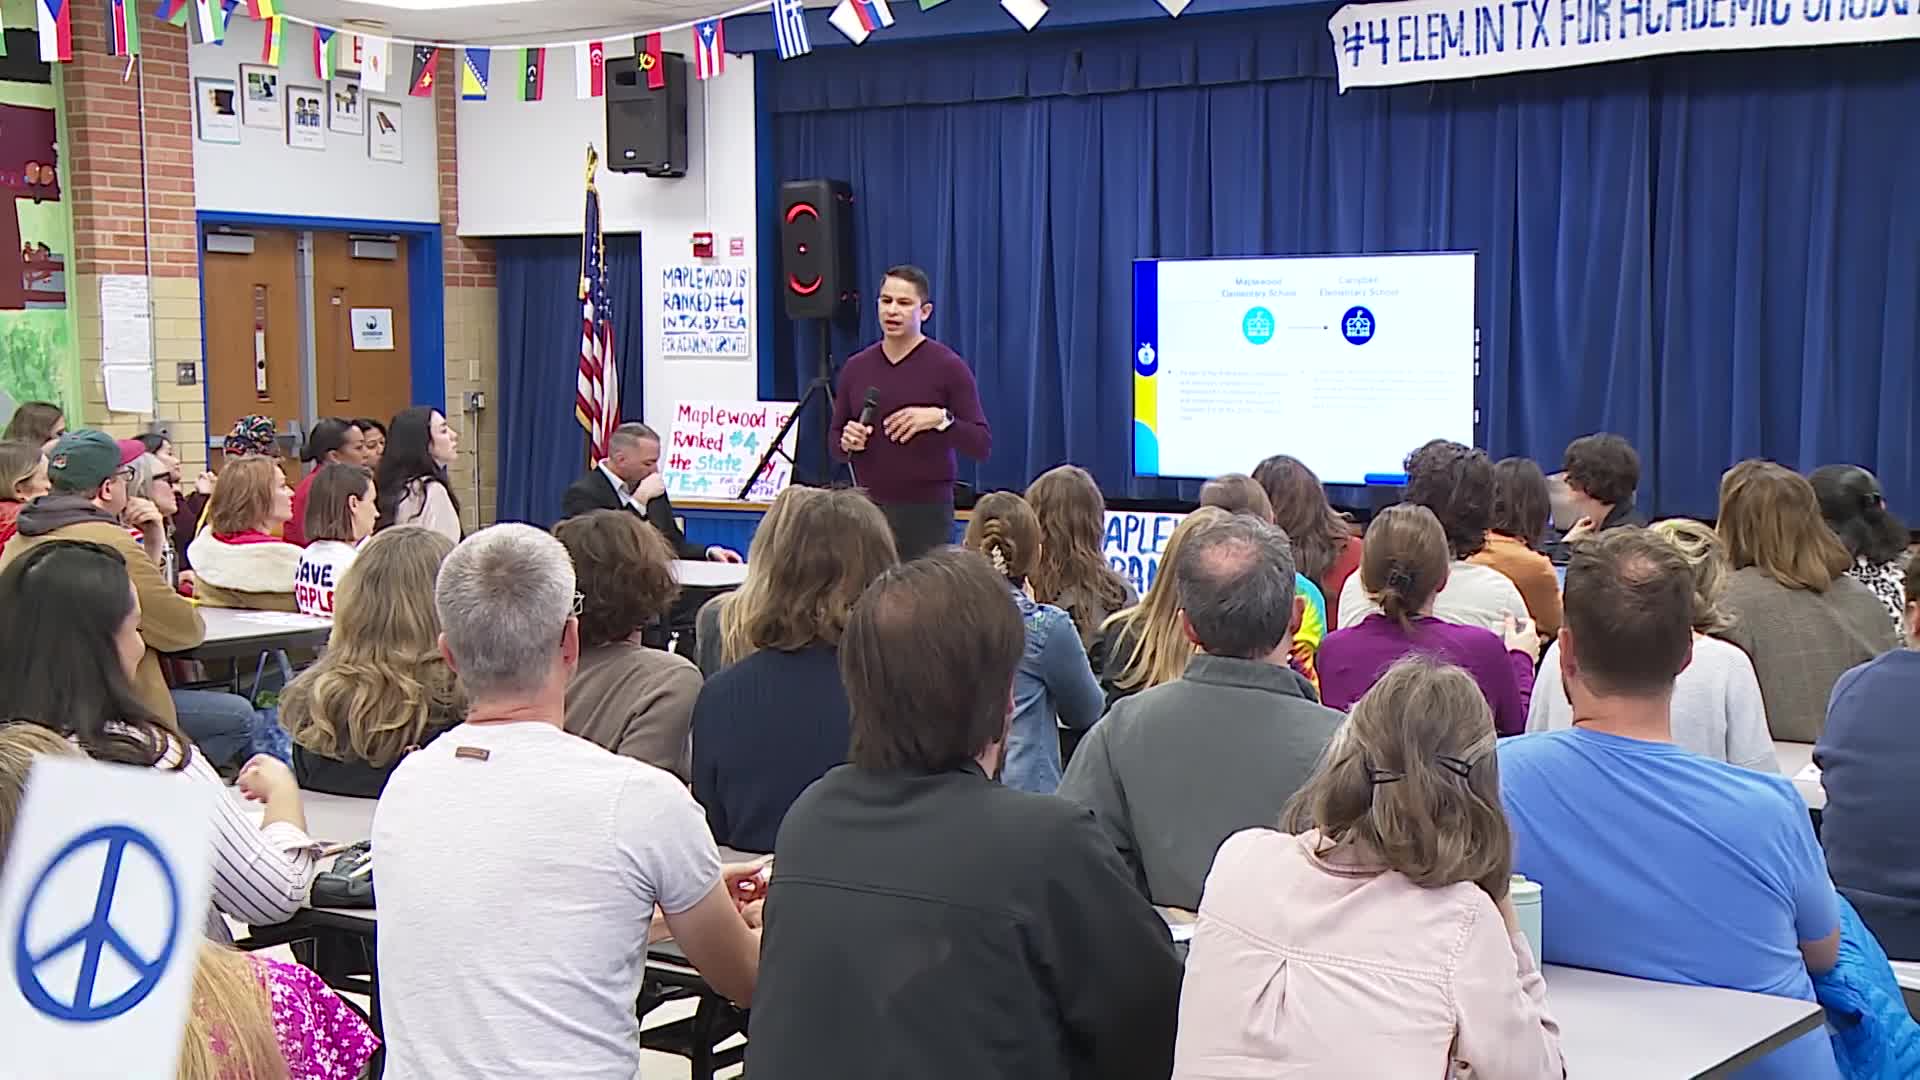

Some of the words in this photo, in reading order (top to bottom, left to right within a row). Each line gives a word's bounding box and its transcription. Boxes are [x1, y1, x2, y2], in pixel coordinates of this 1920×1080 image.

[1343, 18, 1390, 67] #4
[1475, 4, 1505, 56] IN
[1512, 0, 1550, 50] TX
[1560, 0, 1611, 47] FOR
[662, 267, 732, 290] MAPLEWOOD
[735, 268, 748, 288] IS
[662, 291, 712, 313] RANKED
[713, 290, 744, 315] #4
[662, 315, 677, 330] IN
[703, 315, 720, 331] BY
[721, 315, 747, 330] TEA
[677, 404, 767, 429] Maplewood
[673, 431, 724, 453] Ranked
[729, 430, 760, 456] #4
[668, 453, 691, 471] the
[664, 471, 713, 493] TEA
[1103, 514, 1178, 554] APLE
